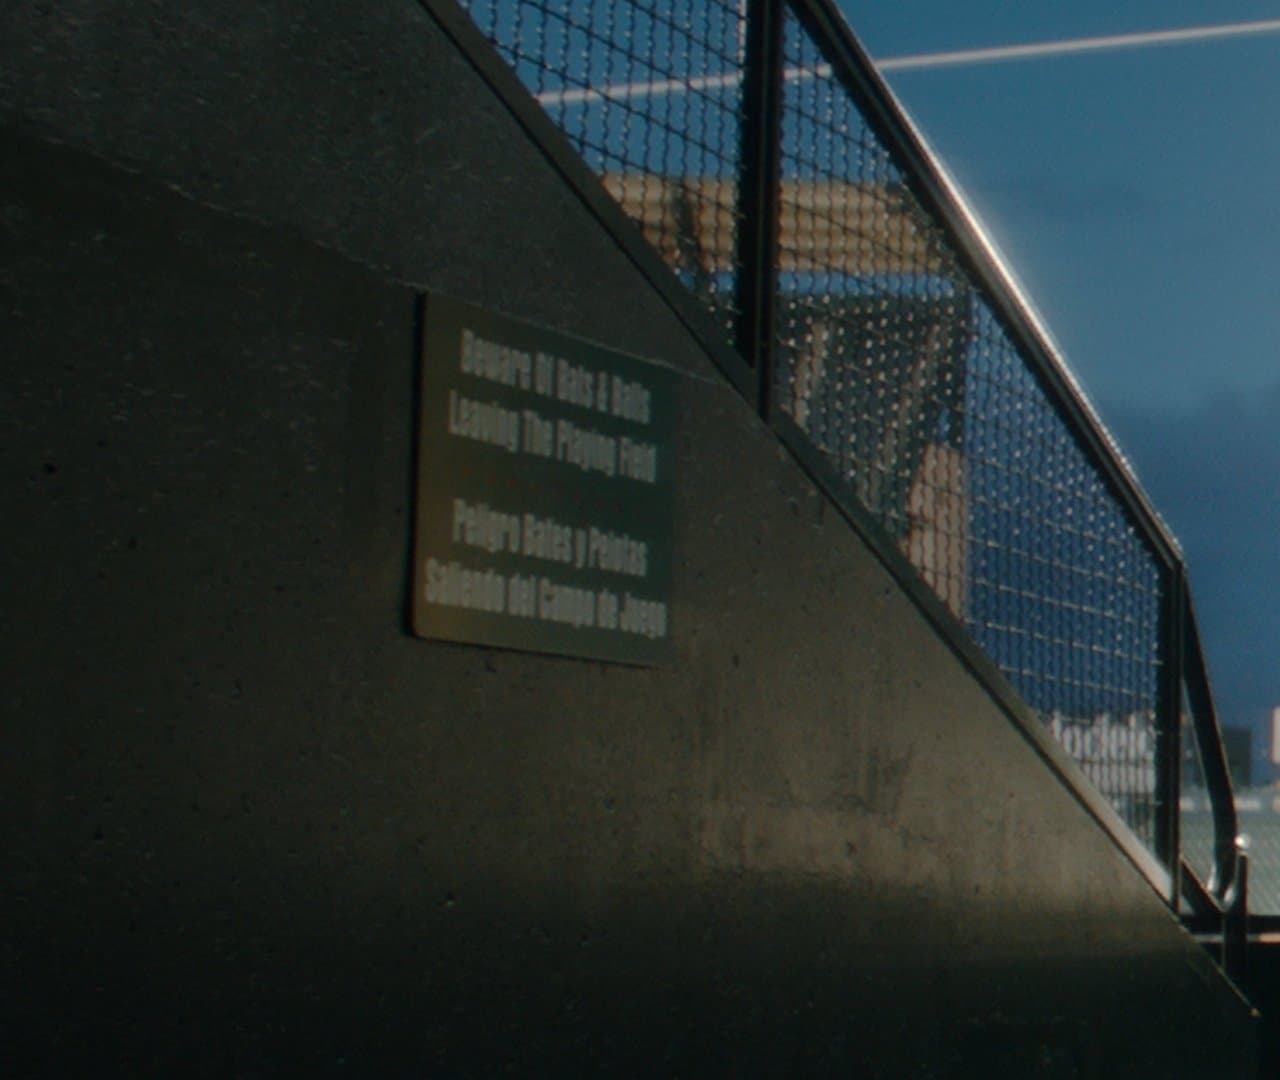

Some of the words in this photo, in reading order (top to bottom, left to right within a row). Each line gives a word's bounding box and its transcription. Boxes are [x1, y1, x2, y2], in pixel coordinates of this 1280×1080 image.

[461, 328, 531, 390] Beware
[557, 358, 594, 409] Bats
[449, 389, 520, 453] Leaving
[522, 409, 553, 457] The
[556, 418, 617, 477] Playing
[619, 436, 657, 484] Field
[452, 497, 520, 553] Peligro
